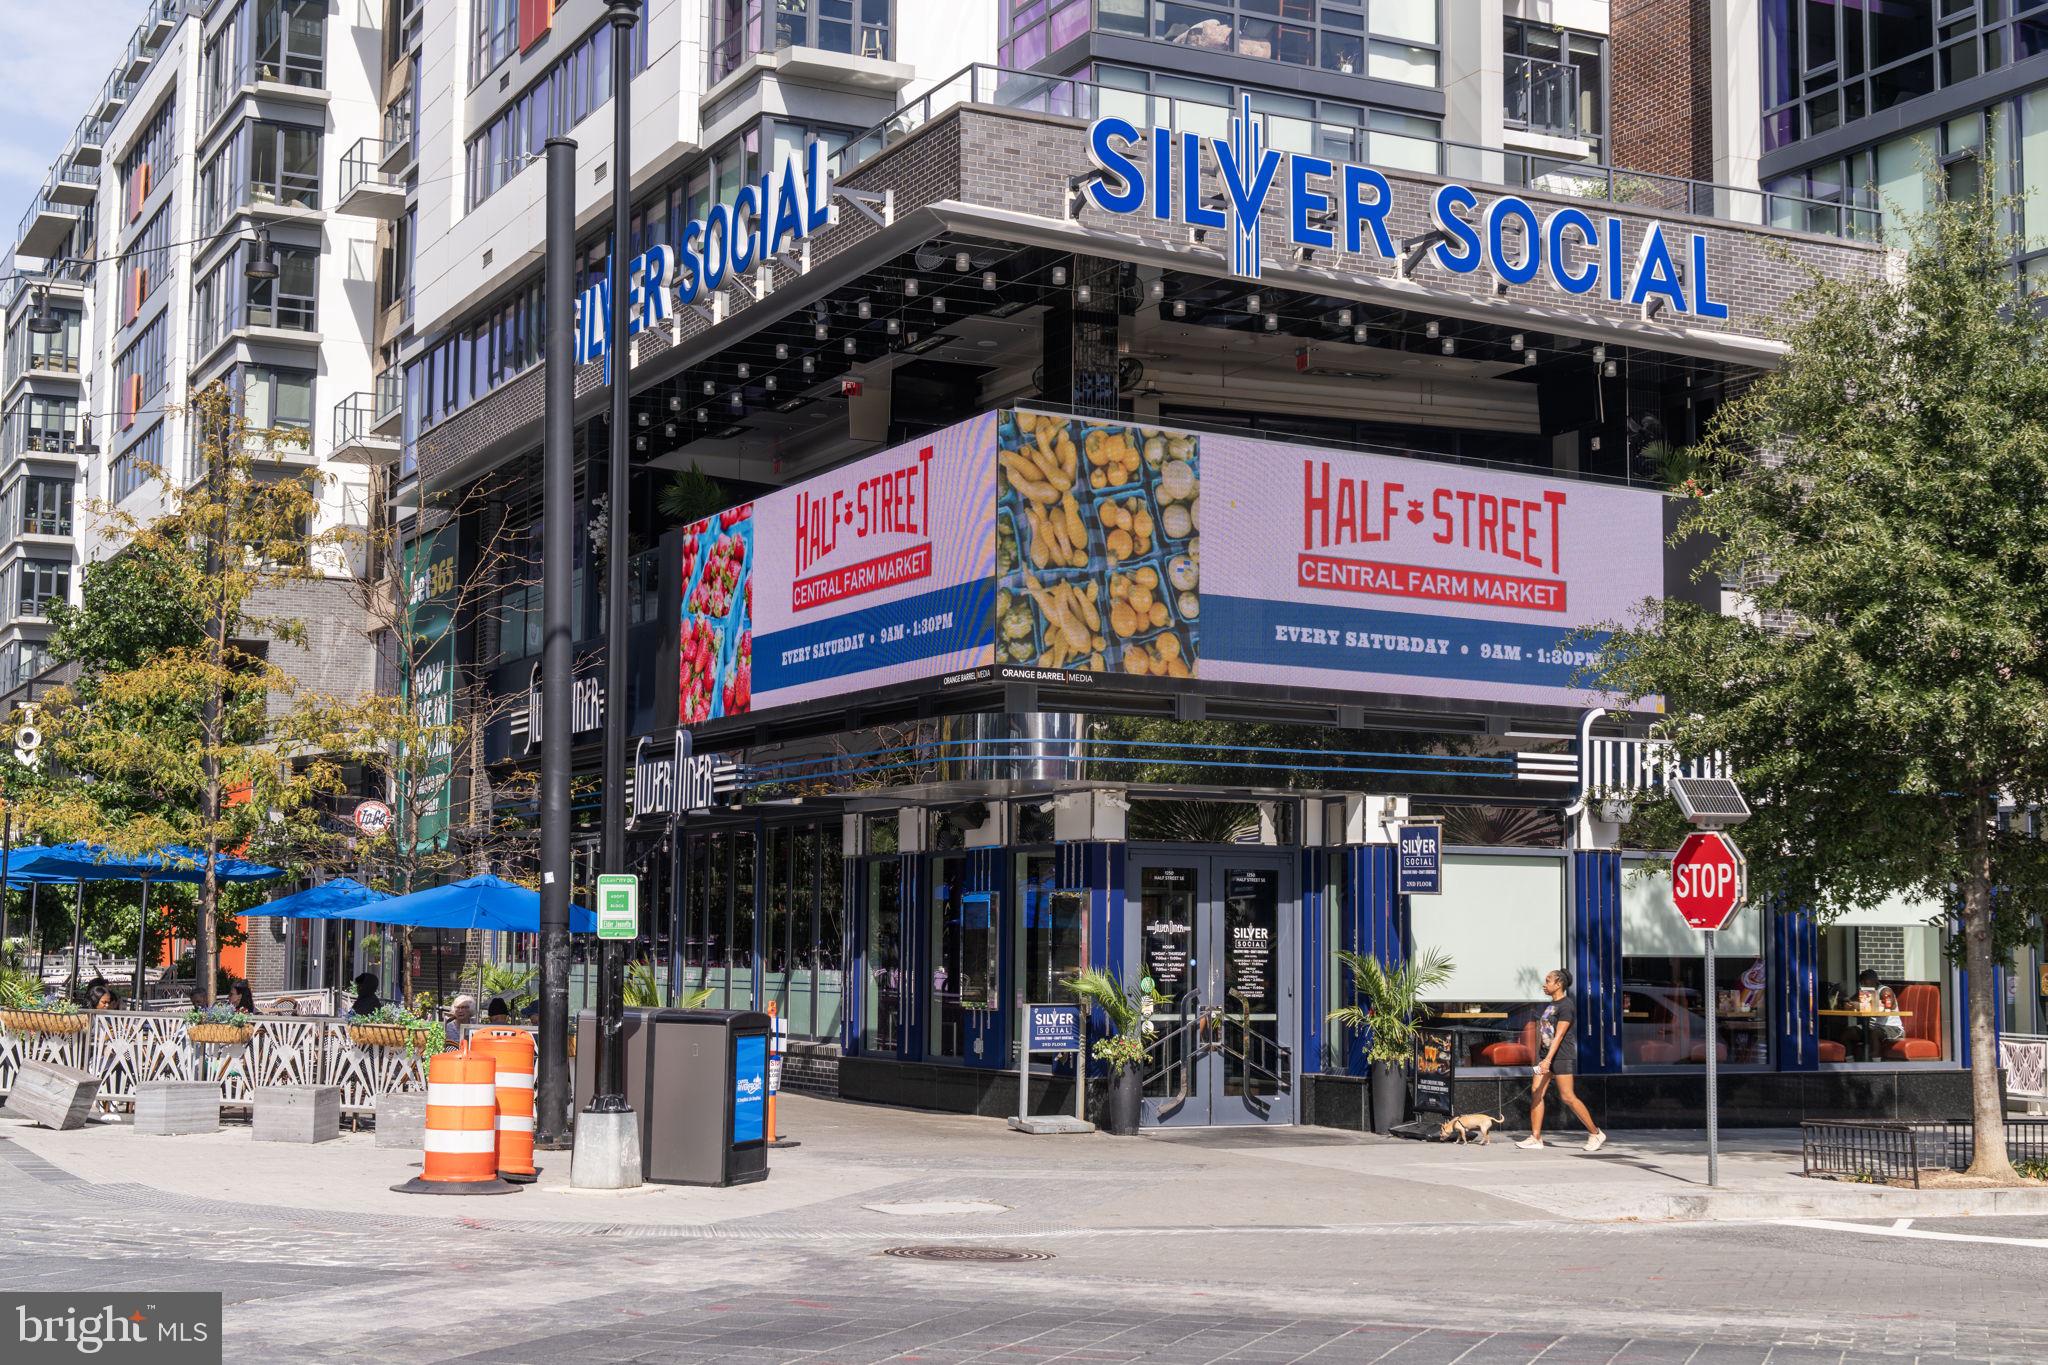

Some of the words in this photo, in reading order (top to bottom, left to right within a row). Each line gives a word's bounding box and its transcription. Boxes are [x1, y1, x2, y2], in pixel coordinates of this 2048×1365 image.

[680, 139, 837, 305] SOCIAL
[1085, 94, 1396, 278] SILVER
[1430, 183, 1729, 320] SOCIAL
[795, 490, 844, 578] HALF
[857, 445, 934, 538] STREET
[1304, 460, 1404, 551] HALF
[1433, 488, 1567, 576] STREET
[794, 582, 842, 606] CENTRAL
[843, 571, 876, 592] FARM
[878, 550, 928, 582] MARKET
[1301, 560, 1404, 592] CENTRAL
[1408, 571, 1469, 598] FARM
[1473, 578, 1559, 606] MARKET
[781, 645, 811, 667] EVERY
[812, 633, 865, 660] SATURDAY
[880, 623, 905, 644] 9AM
[913, 612, 954, 637] 1:30PM
[1275, 624, 1340, 647] EVERY
[1345, 631, 1450, 656] SATURDAY
[1480, 643, 1522, 662] 9AM
[415, 659, 445, 696] NOW
[943, 673, 961, 686] ORANGE
[961, 672, 976, 682] BARREL
[977, 669, 991, 679] MEDIA
[1001, 668, 1036, 680] ORANGE
[1036, 671, 1066, 682] BARREL
[1068, 674, 1094, 683] MEDIA
[1402, 832, 1437, 855] SILVER
[1405, 857, 1433, 866] SOCIAL
[1675, 862, 1732, 899] STOP
[1233, 922, 1269, 940] SILVER
[1035, 1008, 1074, 1026] SILVER
